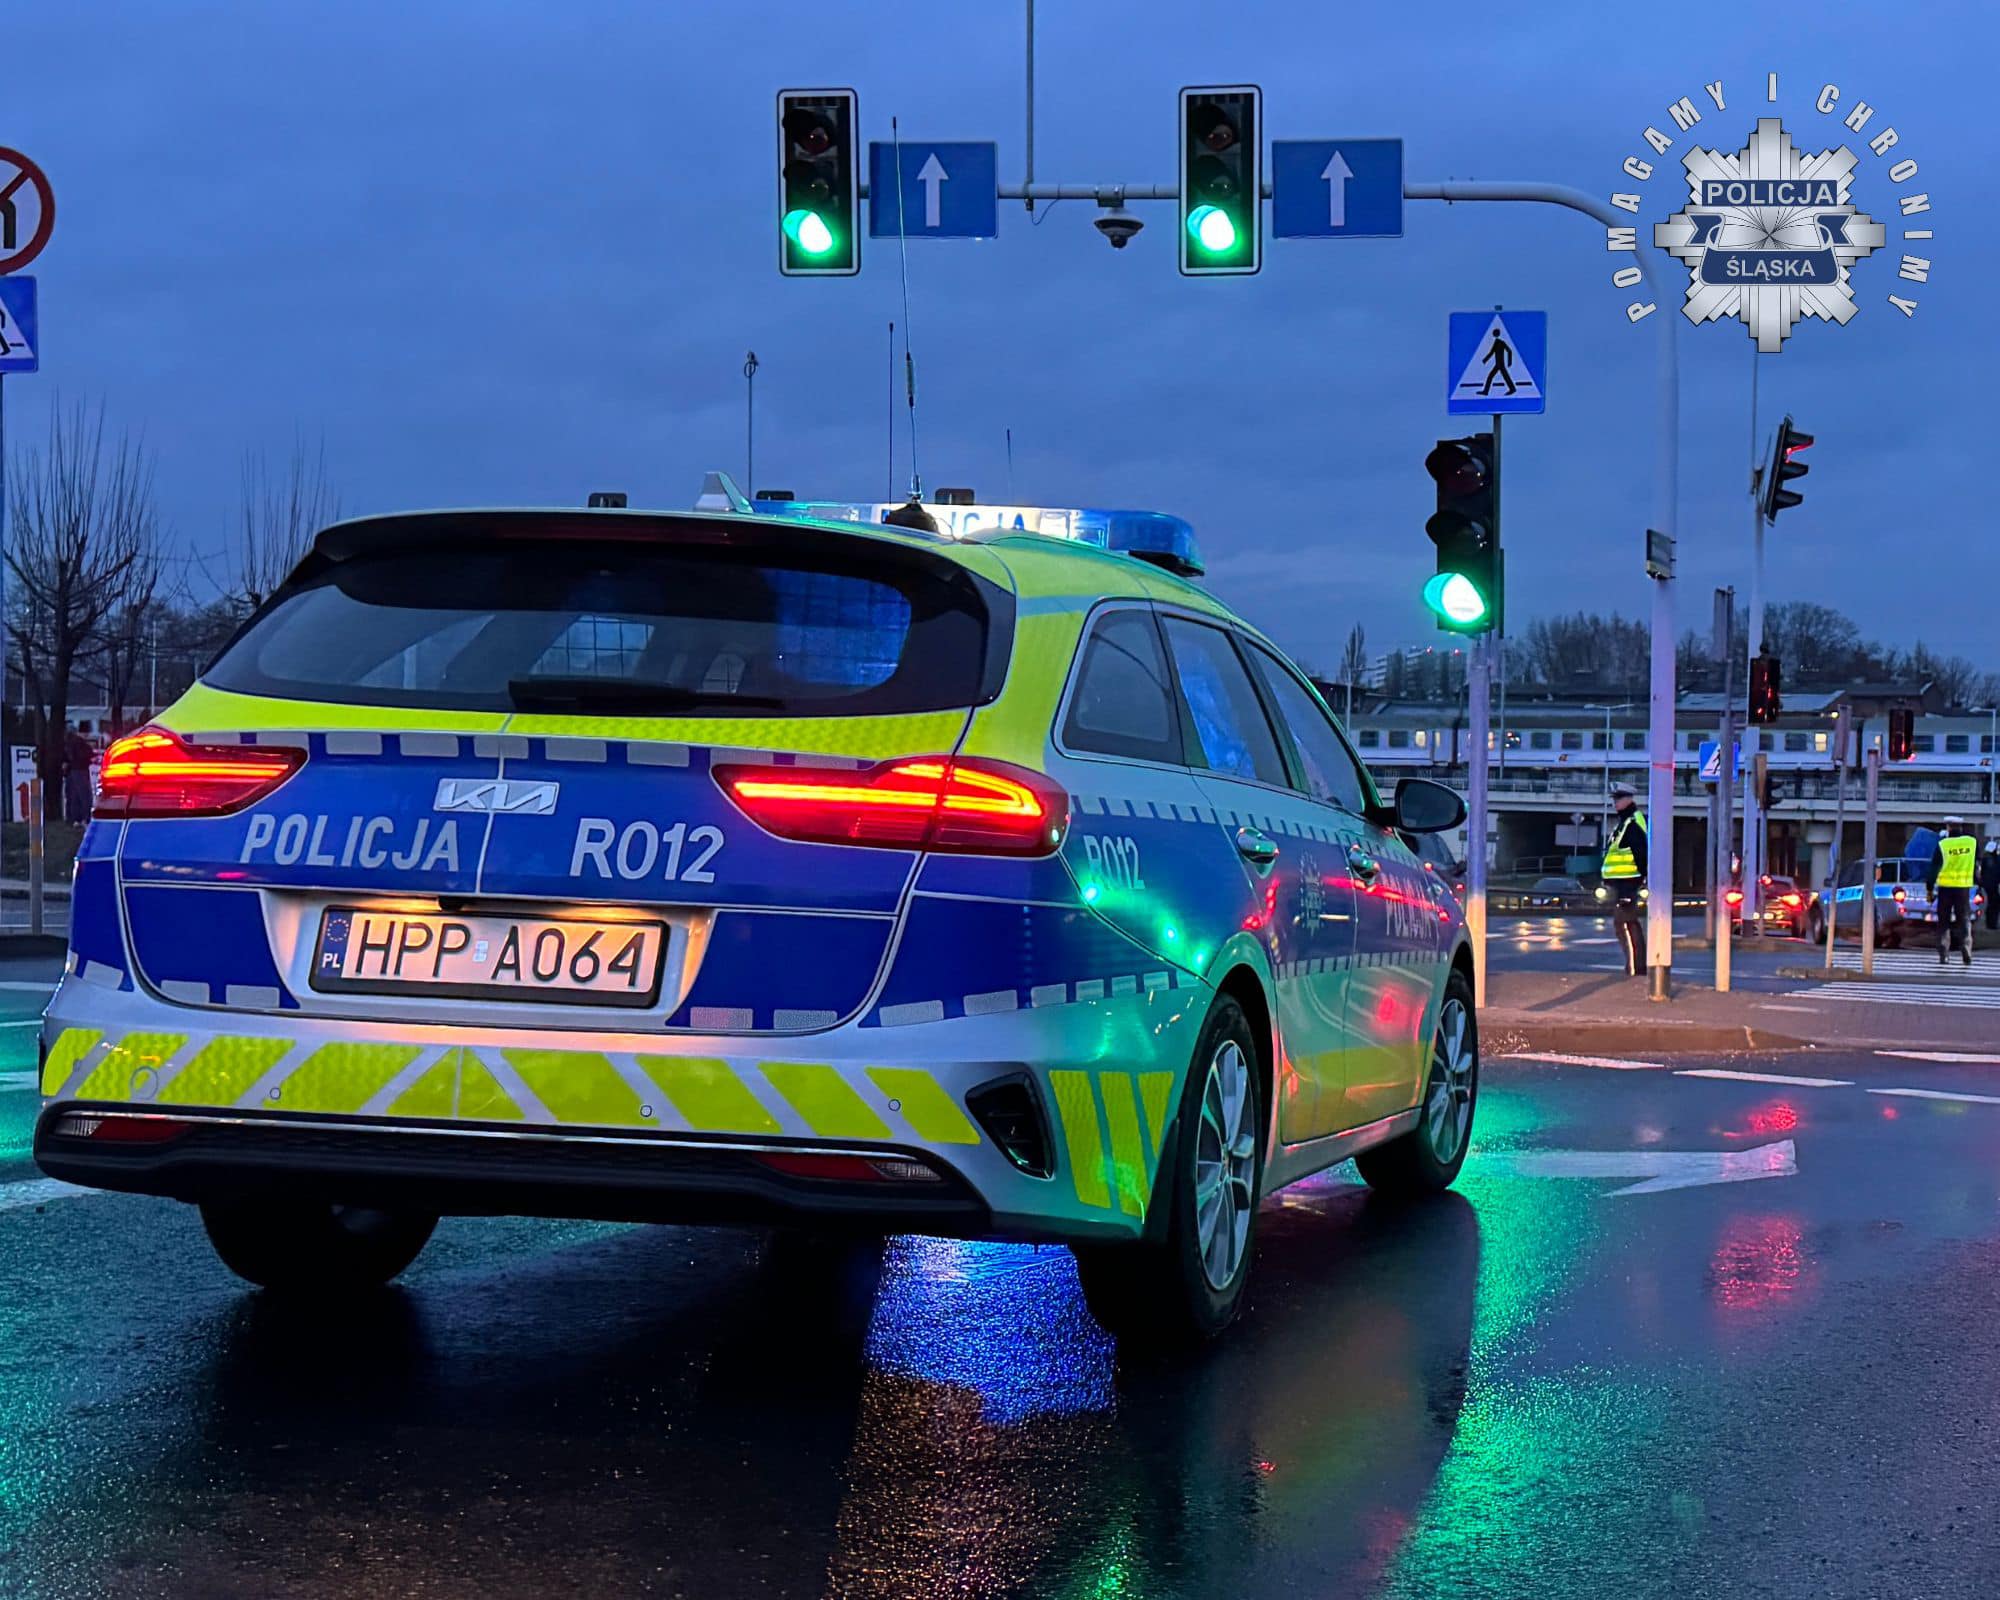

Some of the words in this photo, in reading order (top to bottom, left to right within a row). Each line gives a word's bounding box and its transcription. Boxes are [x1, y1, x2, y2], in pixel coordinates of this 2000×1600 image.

[437, 781, 558, 813] KIA
[239, 813, 460, 872] POLICJA
[322, 952, 341, 969] PL
[355, 919, 472, 978] HPP
[490, 924, 646, 987] A064
